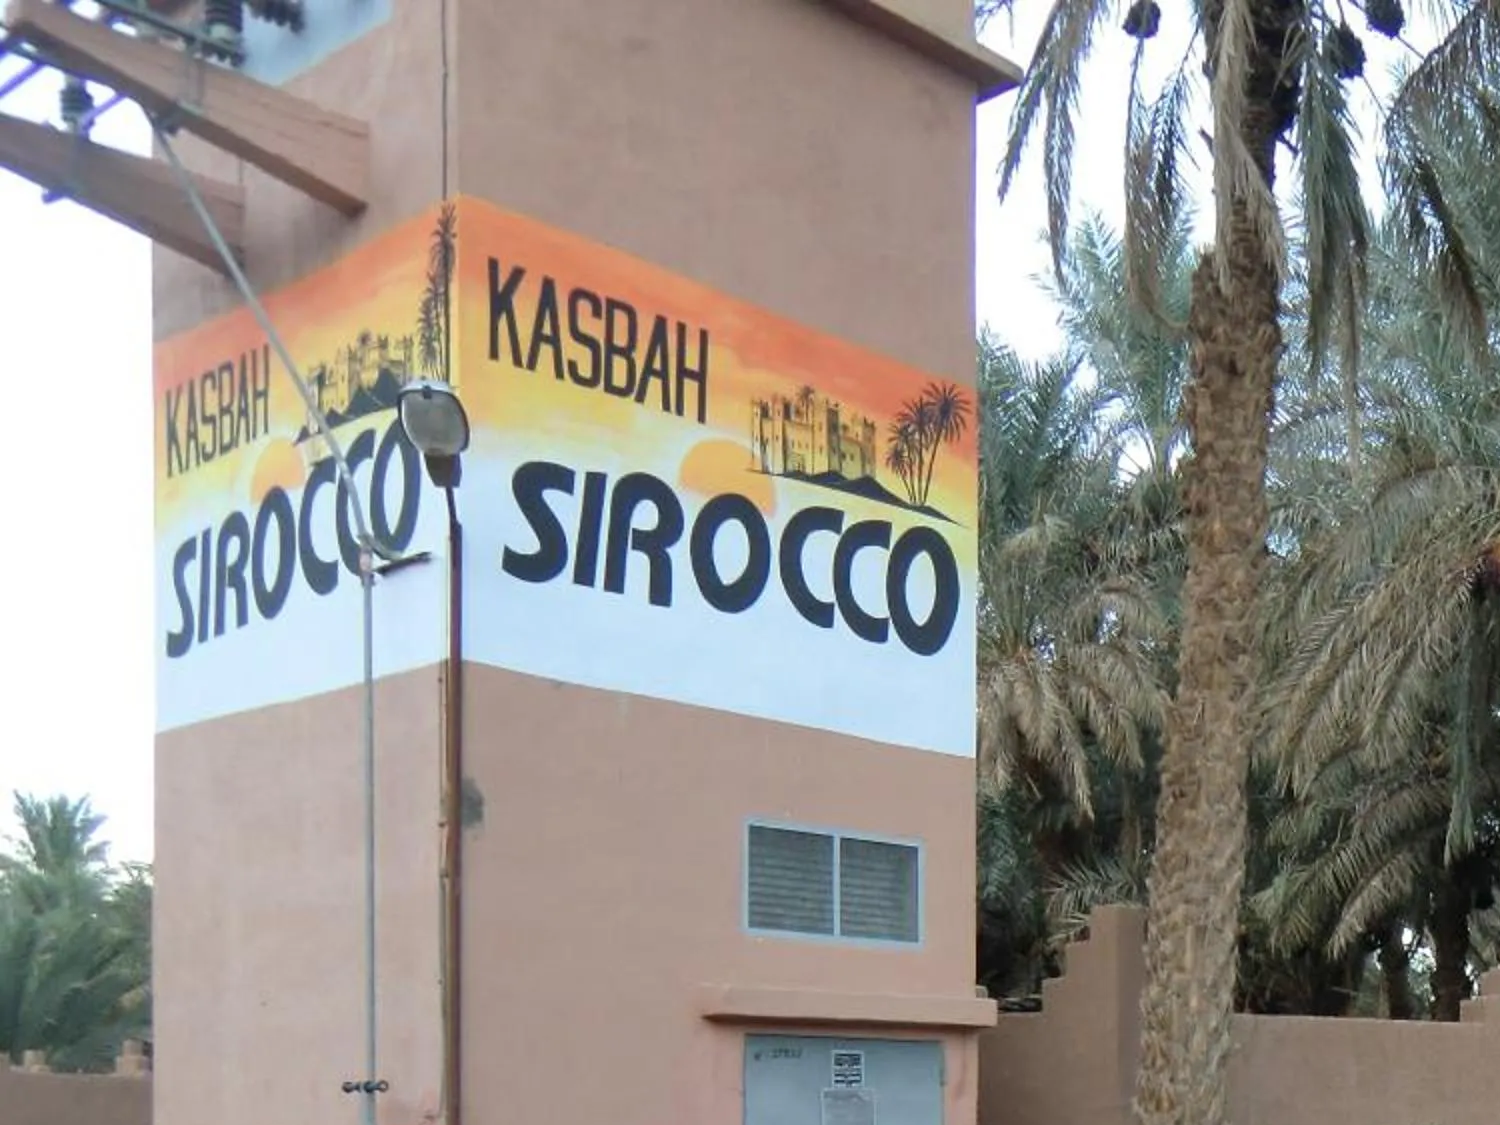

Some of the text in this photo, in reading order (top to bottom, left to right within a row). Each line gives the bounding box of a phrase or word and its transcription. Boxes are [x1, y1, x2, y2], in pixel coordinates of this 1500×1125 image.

[166, 343, 270, 479] KASBAH
[486, 256, 709, 424] KASBAH
[165, 415, 422, 659] SIROCCO
[501, 460, 961, 657] SIROCCO
